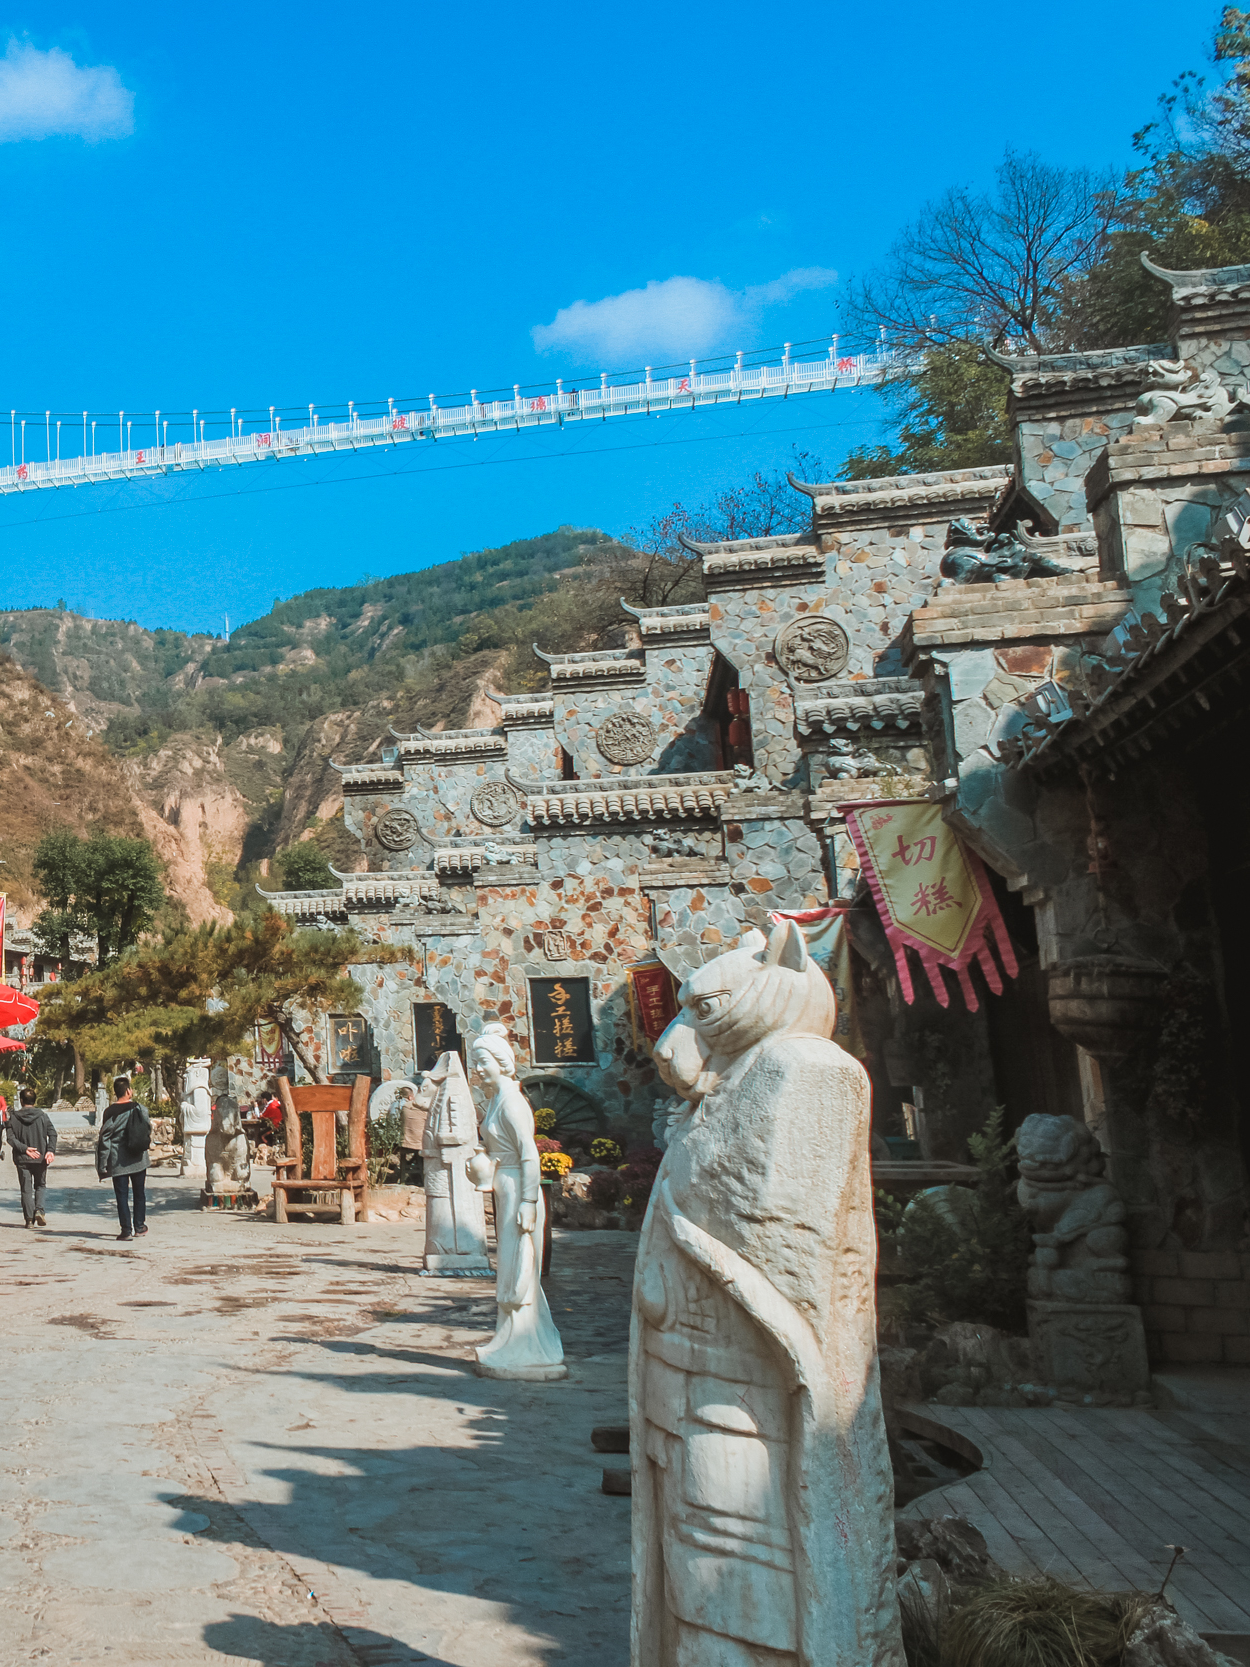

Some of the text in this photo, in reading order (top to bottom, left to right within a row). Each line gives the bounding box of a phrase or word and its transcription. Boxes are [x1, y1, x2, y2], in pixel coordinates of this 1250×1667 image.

[891, 834, 963, 917] 切糕
[547, 982, 578, 1058] 手工搓搓
